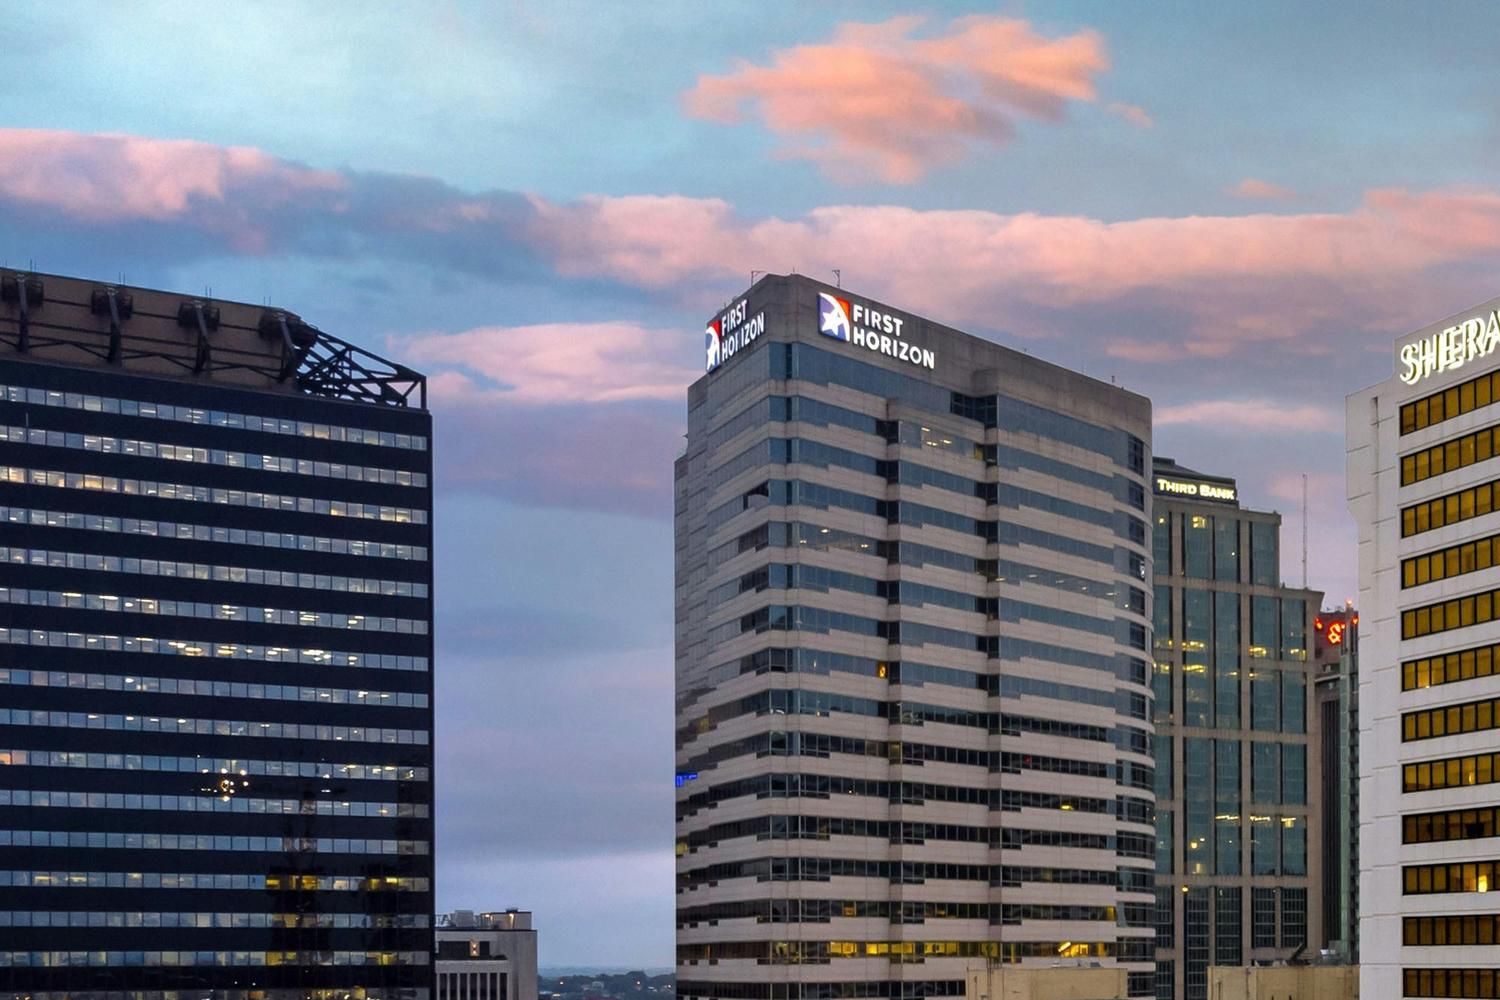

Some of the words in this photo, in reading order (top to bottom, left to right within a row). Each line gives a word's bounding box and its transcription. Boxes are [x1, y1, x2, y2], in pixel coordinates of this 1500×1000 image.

[721, 299, 748, 337] FIRST
[853, 304, 904, 337] FIRST
[853, 326, 935, 370] HORIZON
